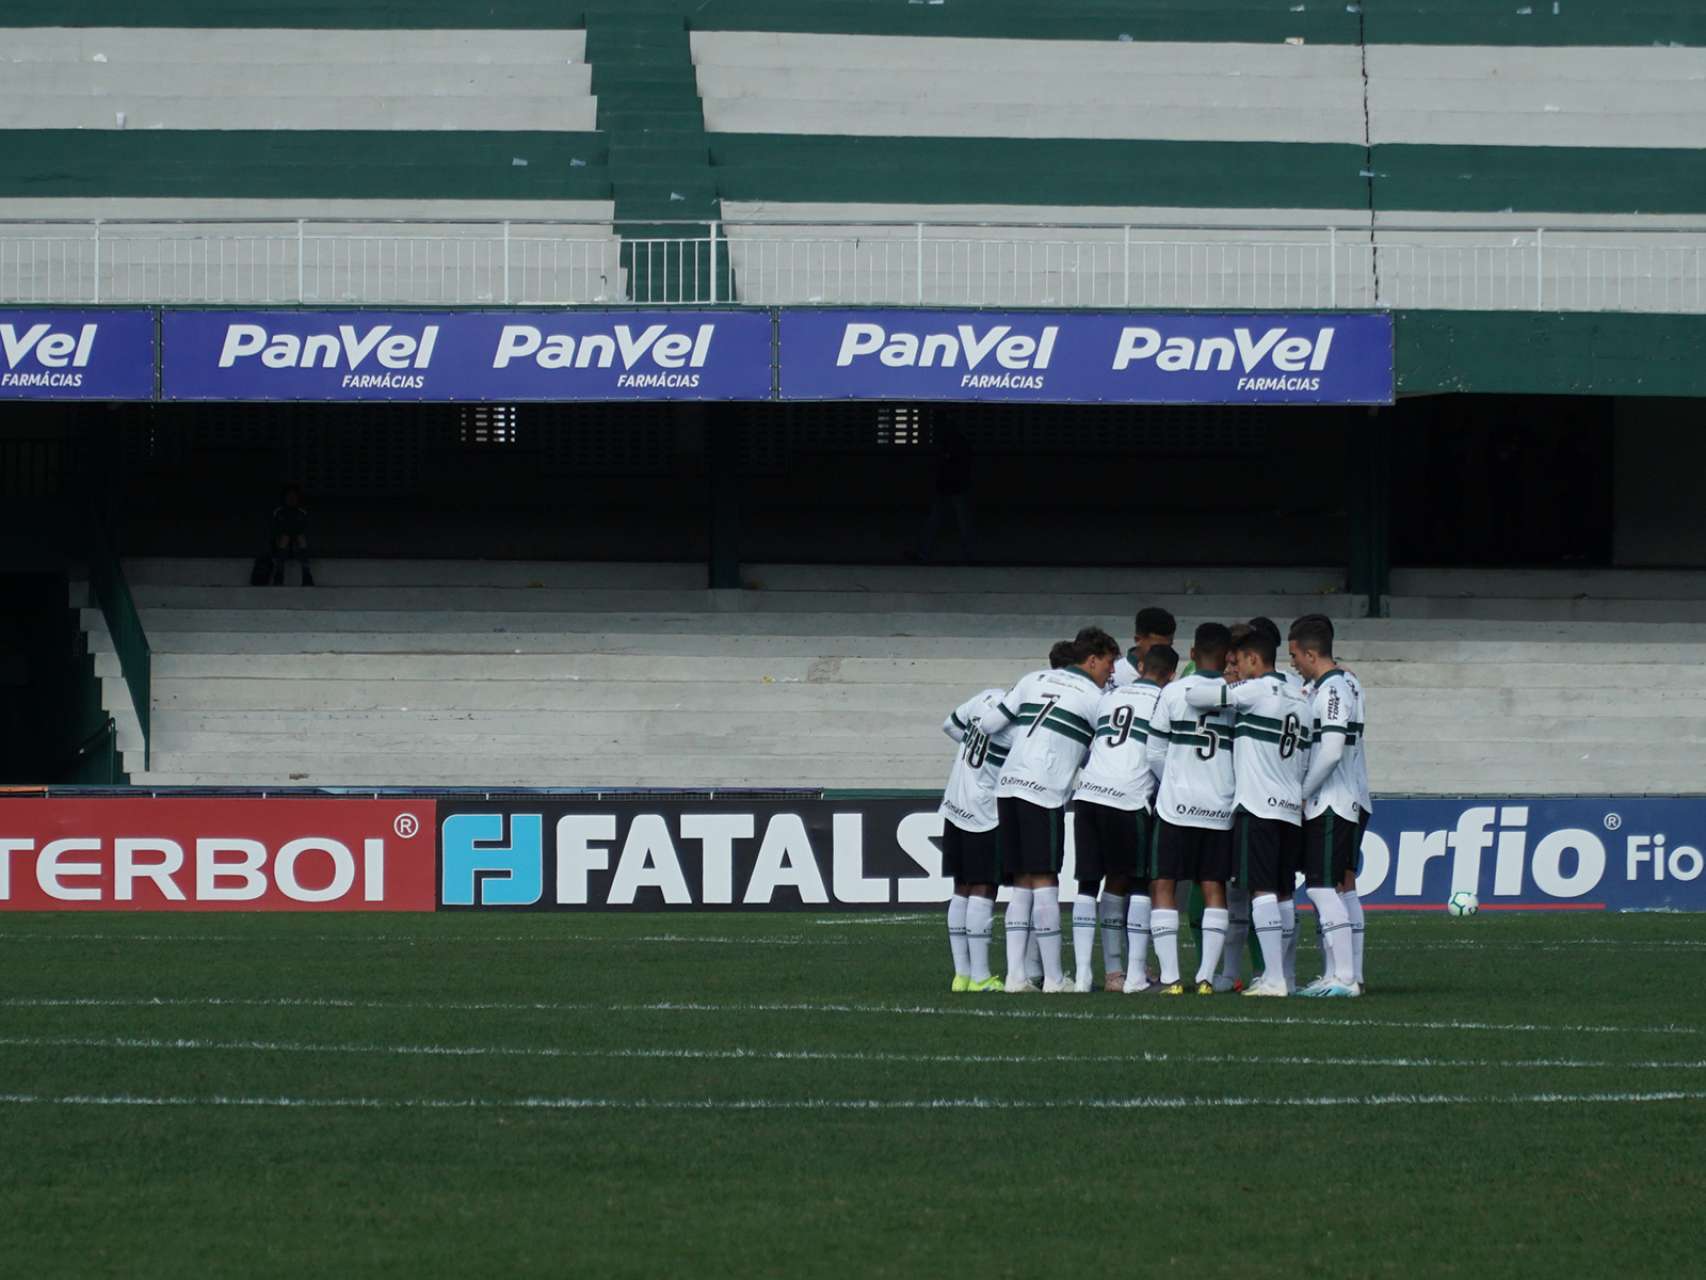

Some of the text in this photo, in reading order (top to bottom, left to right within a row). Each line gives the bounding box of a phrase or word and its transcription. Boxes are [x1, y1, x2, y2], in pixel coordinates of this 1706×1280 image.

[218, 324, 439, 371] PanVel
[492, 324, 715, 372] PanVel
[836, 324, 1059, 372] PanVel
[1112, 326, 1335, 375] PanVel
[1, 370, 83, 387] FARMÁCIAS
[341, 371, 424, 389] FARMÁCIAS
[617, 371, 700, 389] FARMÁCIAS
[960, 372, 1044, 389] FARMÁCIAS
[1237, 374, 1320, 391] FARMÁCIAS
[1026, 692, 1061, 739] 7
[1106, 703, 1135, 749] 9
[1195, 709, 1220, 761] 5
[1626, 833, 1704, 881] Fio
